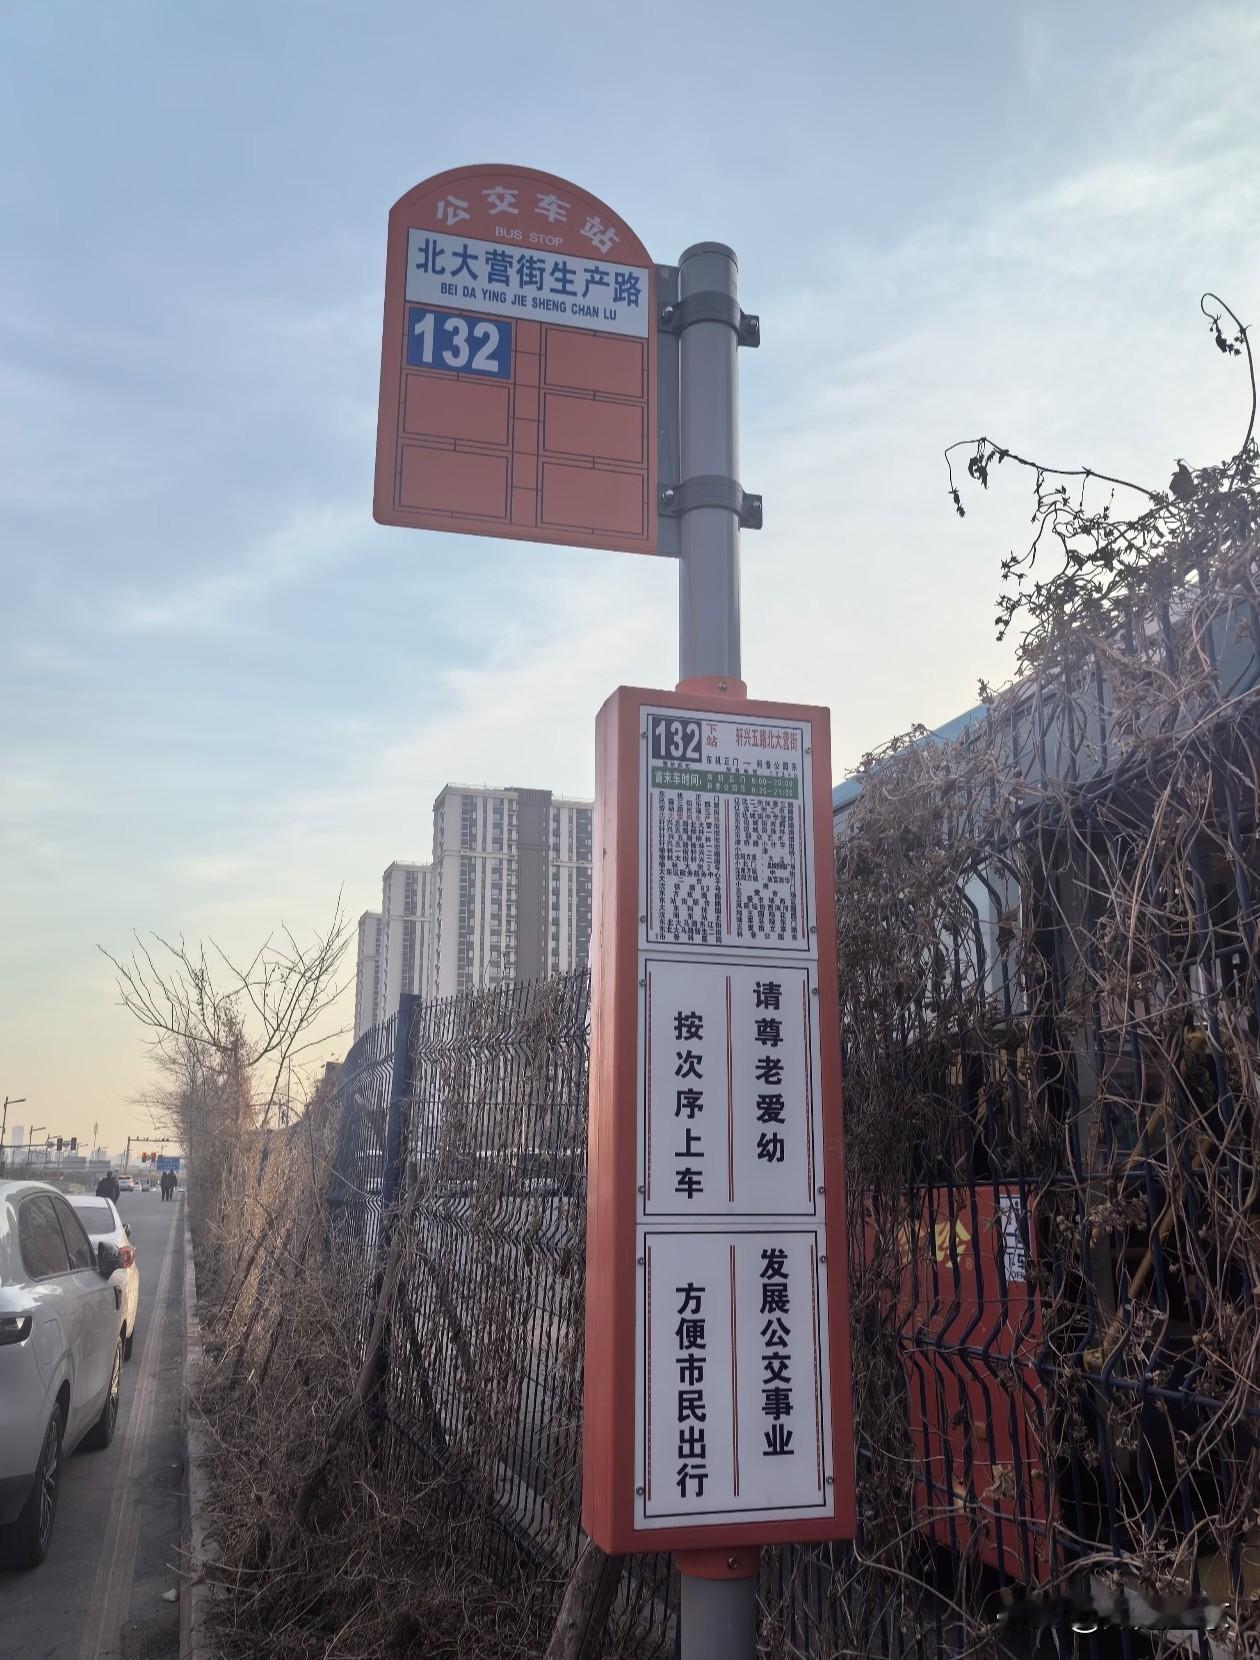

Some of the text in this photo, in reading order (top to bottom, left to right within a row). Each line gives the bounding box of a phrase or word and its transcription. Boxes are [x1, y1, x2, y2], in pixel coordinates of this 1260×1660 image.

[435, 185, 620, 255] 公交车站
[495, 226, 564, 247] BUS STOP
[416, 237, 643, 308] 北大营街生产路
[440, 281, 617, 321] BEI DA YING JIE SHENG CHAN LU
[413, 312, 501, 373] 132
[655, 720, 700, 759] 132
[674, 1011, 705, 1200] 按次序上车
[753, 981, 786, 1163] 请尊老爱幼
[760, 1247, 795, 1457] 发展公交事业
[675, 1282, 709, 1498] 方便市民出行
